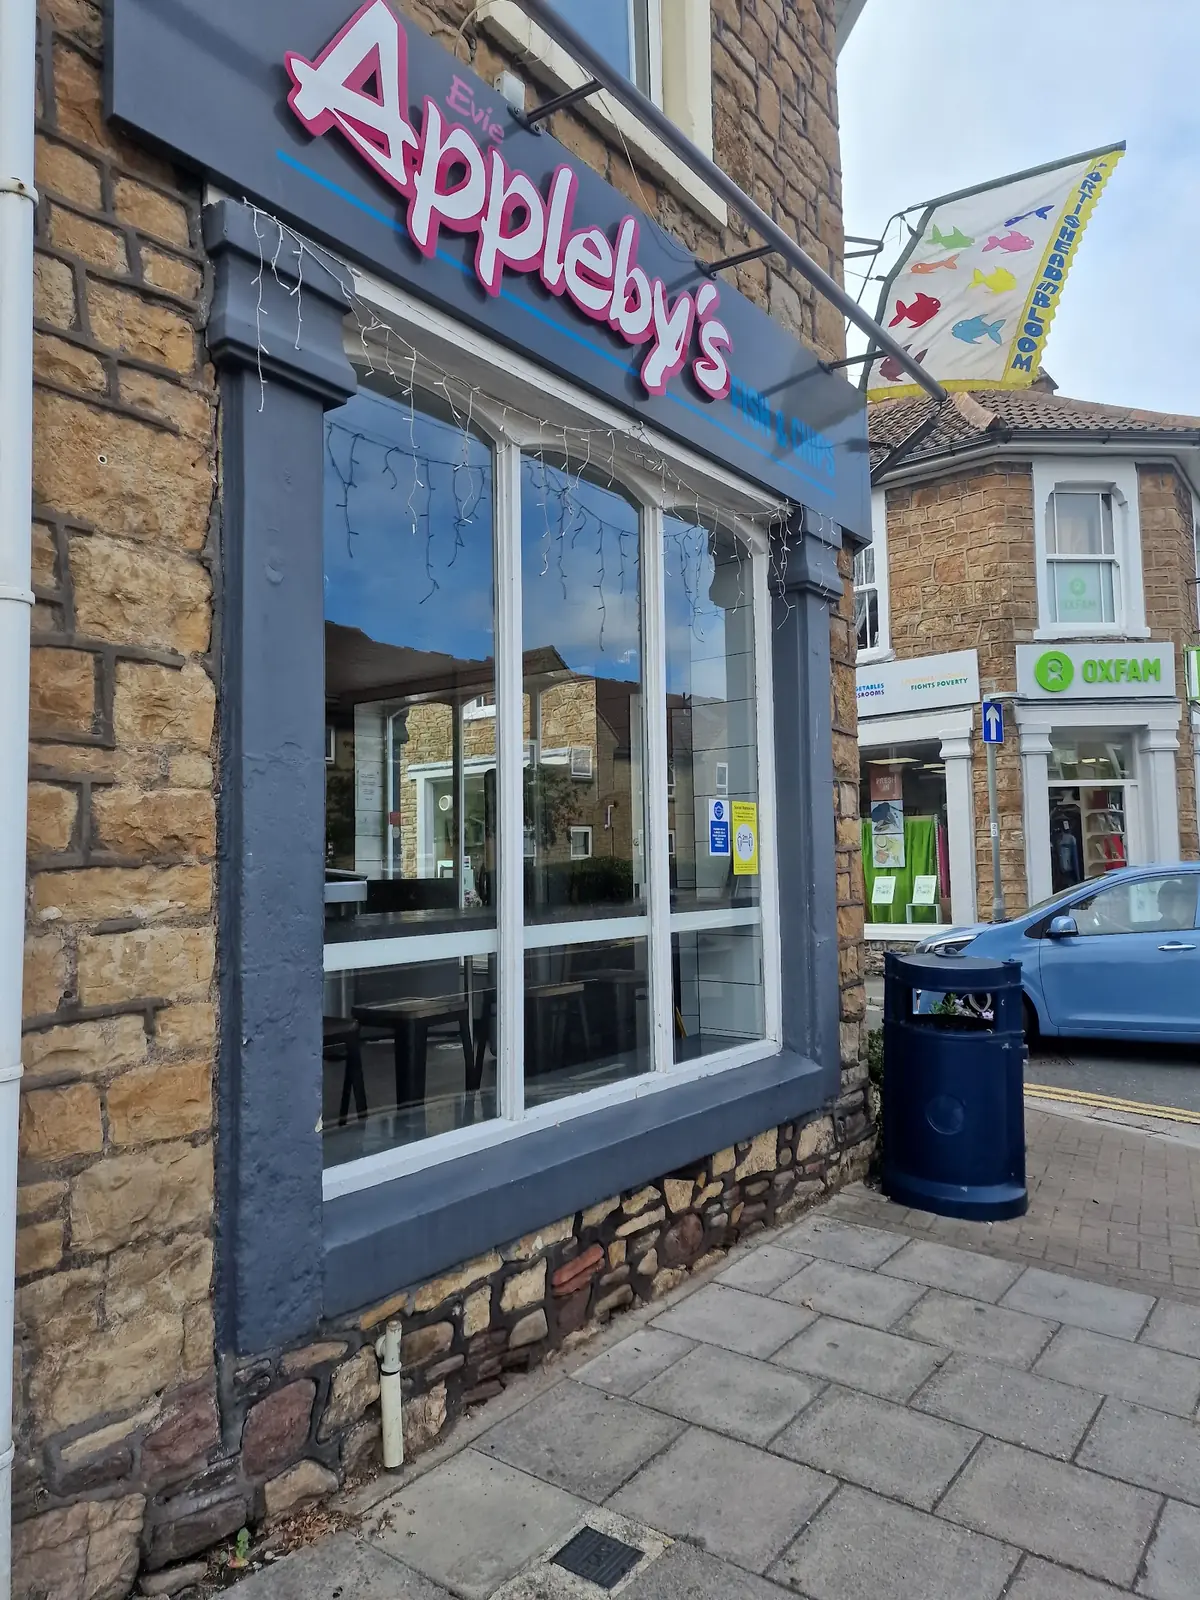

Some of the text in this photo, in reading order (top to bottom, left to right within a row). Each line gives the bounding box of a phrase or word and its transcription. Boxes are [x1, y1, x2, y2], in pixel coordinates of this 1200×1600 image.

[445, 74, 505, 144] Evie
[284, 0, 733, 400] Appleby's
[1011, 290, 1051, 372] BLOOM
[731, 375, 835, 478] FISH & CHIPS
[911, 682, 935, 690] FIGHTS
[937, 678, 968, 687] POVERTY
[1082, 658, 1161, 683] OXFAM
[875, 777, 897, 785] FRESH
